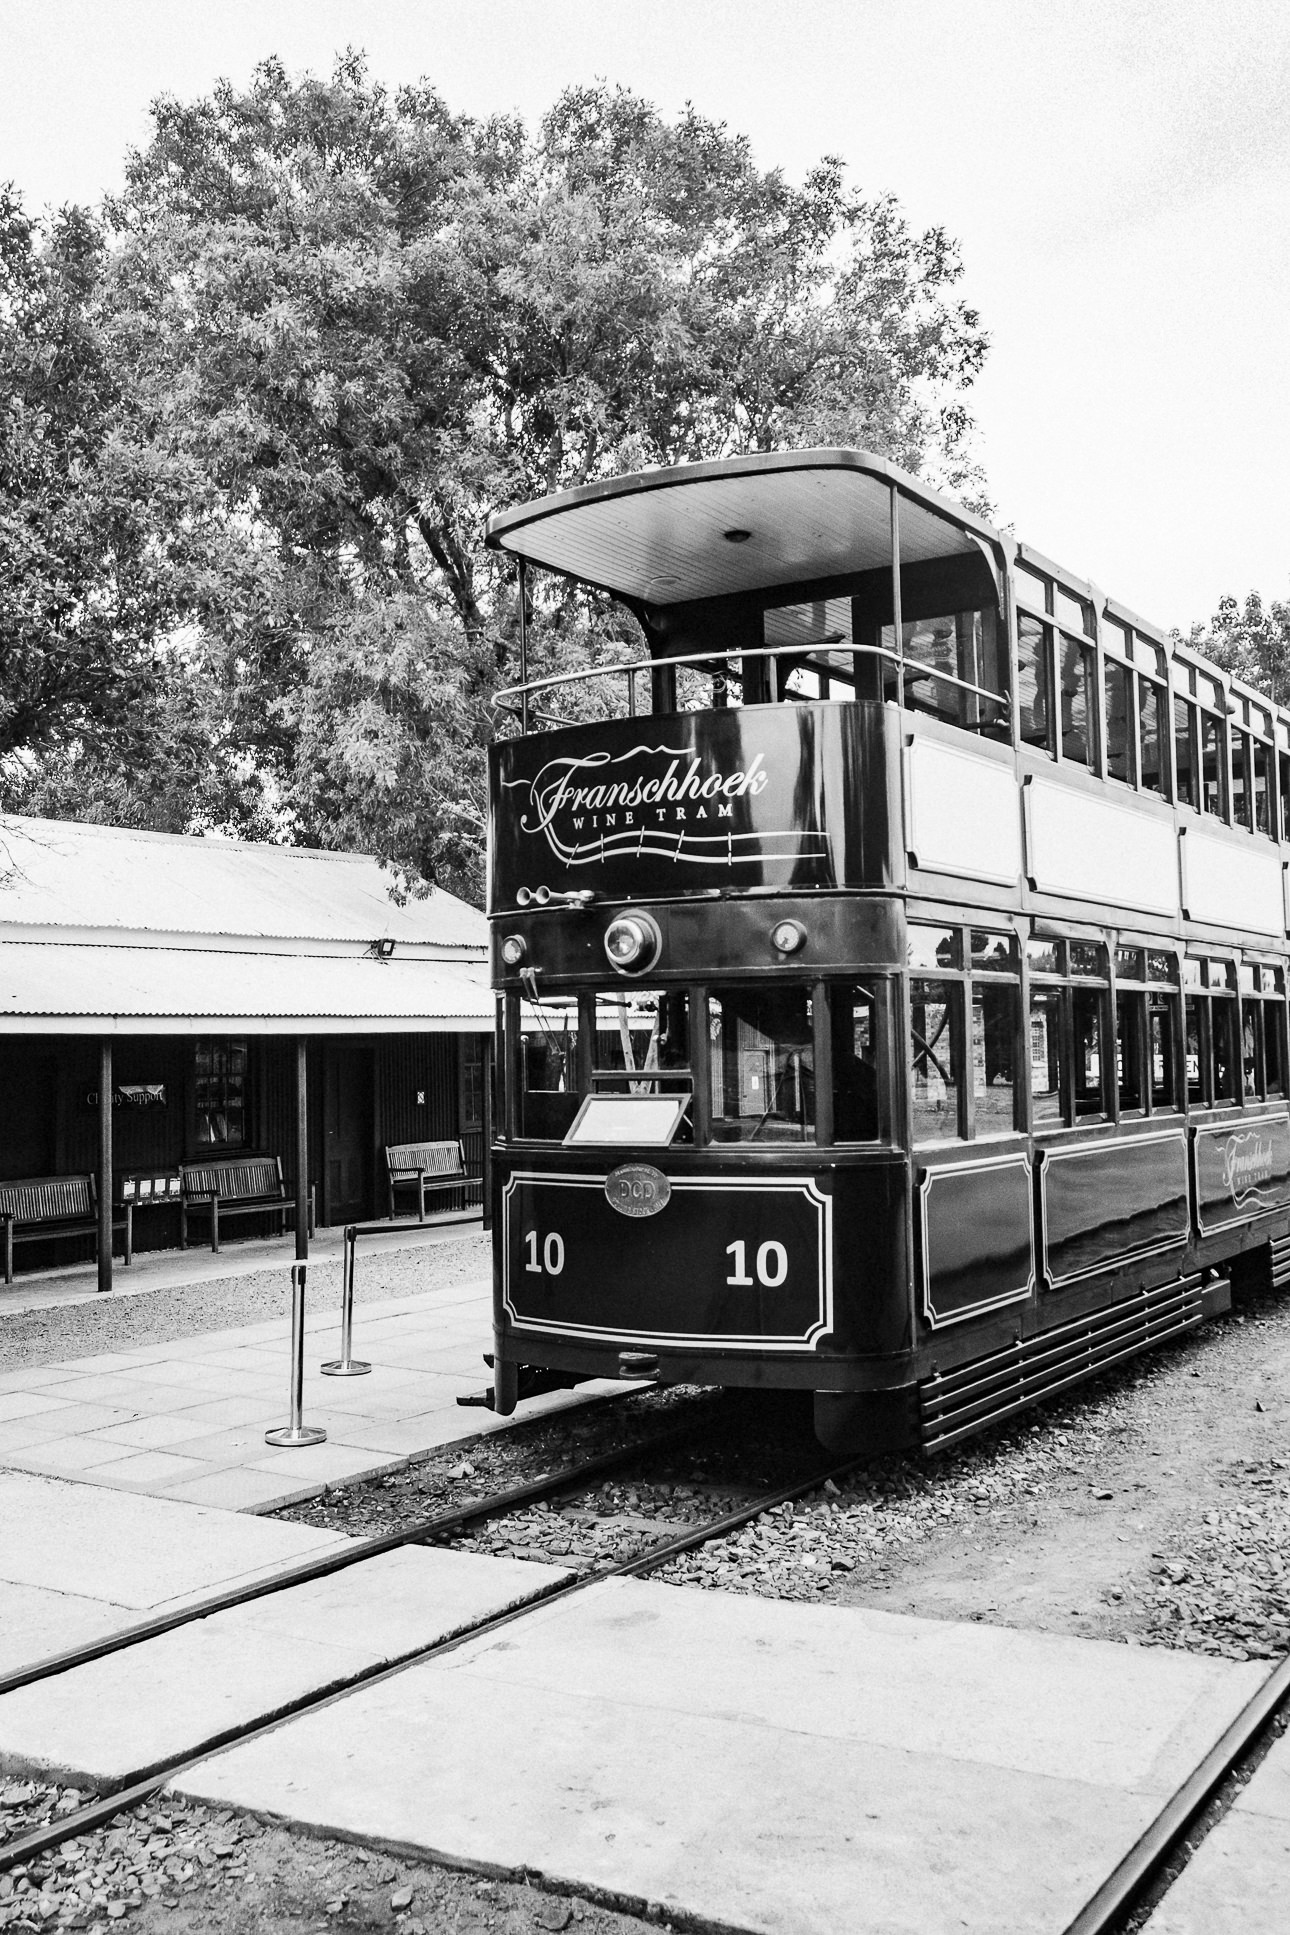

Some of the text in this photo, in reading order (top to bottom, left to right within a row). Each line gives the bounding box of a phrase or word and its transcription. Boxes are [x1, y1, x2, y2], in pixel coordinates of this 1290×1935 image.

[521, 752, 769, 833] Franschhoek
[573, 802, 734, 830] WINE TRAM
[126, 1090, 163, 1104] Support
[618, 1179, 656, 1199] DCD
[525, 1230, 565, 1276] 10
[725, 1240, 789, 1288] 10
